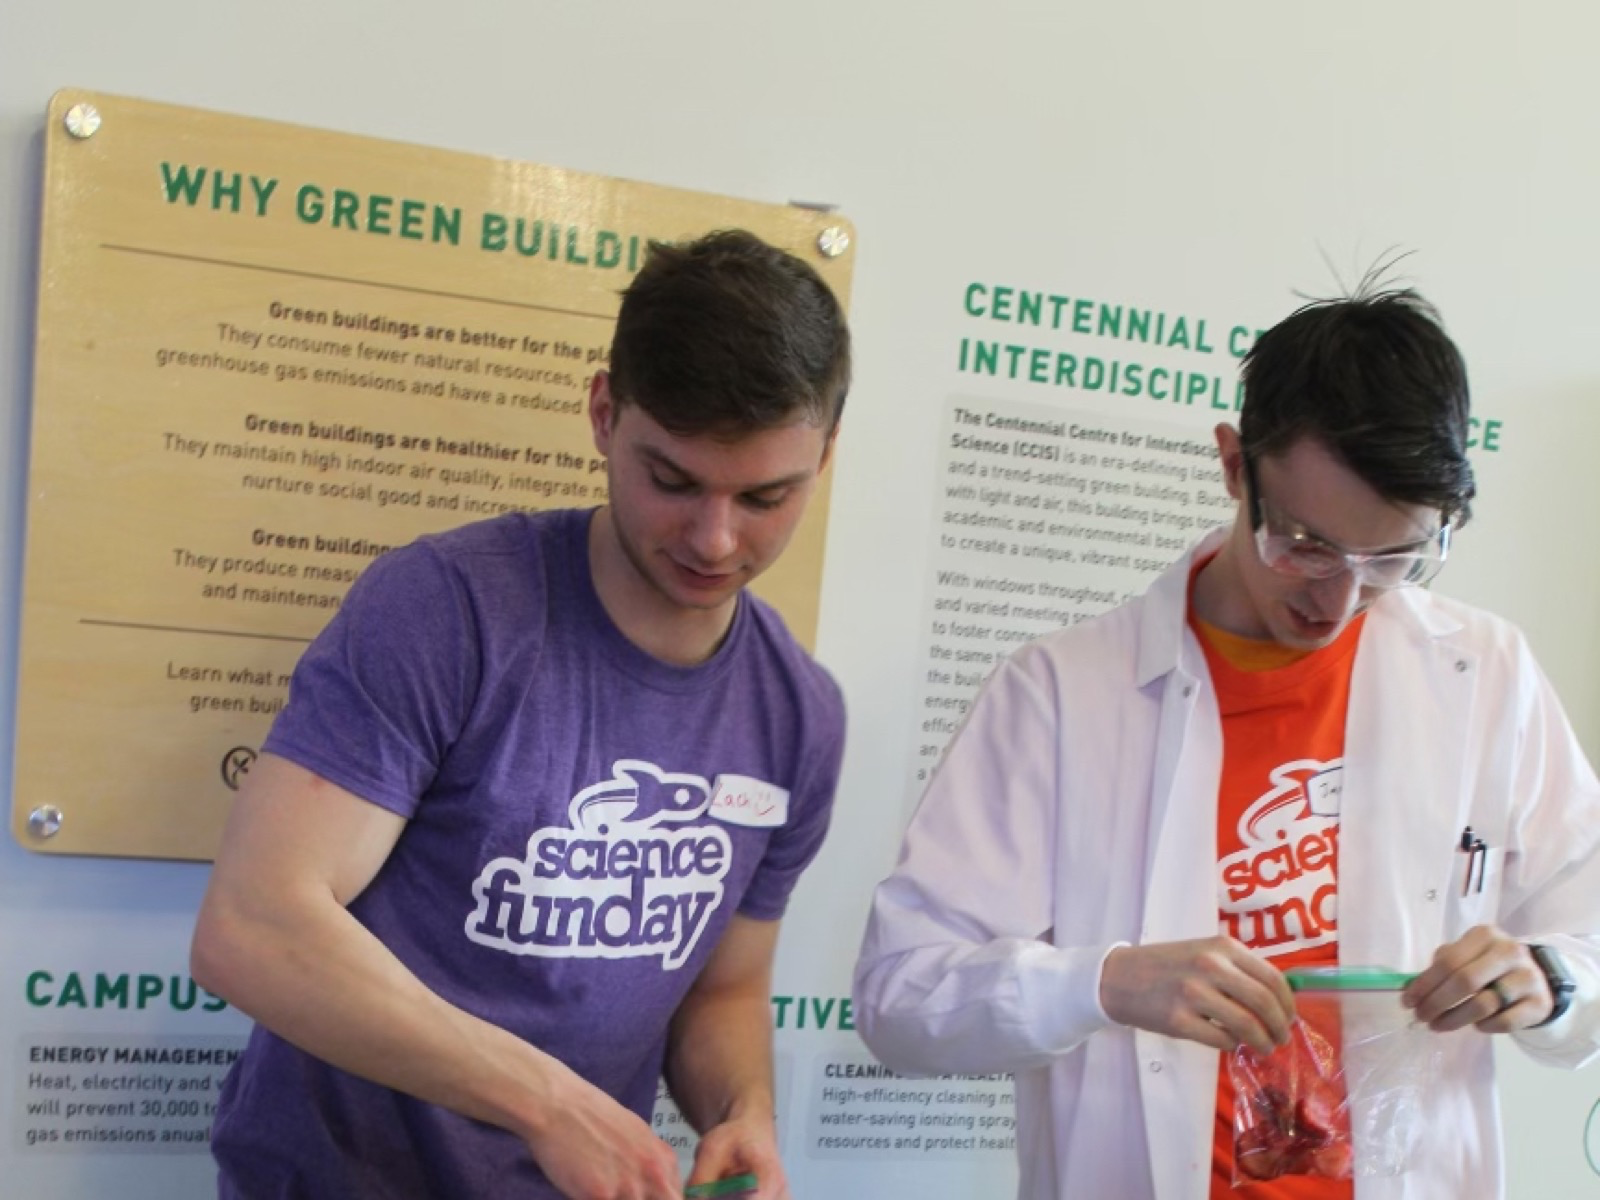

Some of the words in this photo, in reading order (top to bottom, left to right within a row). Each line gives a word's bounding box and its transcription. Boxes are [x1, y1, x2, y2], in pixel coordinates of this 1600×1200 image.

[160, 161, 279, 217] WHY
[296, 184, 462, 246] GREEN
[480, 212, 641, 272] BUILDI
[269, 301, 327, 325] Green
[332, 310, 420, 340] buildings
[424, 325, 455, 343] are
[460, 327, 516, 351] better
[521, 336, 549, 355] for
[553, 340, 581, 360] the
[964, 282, 1213, 353] CENTENNIAL
[217, 322, 262, 350] They
[266, 331, 352, 358] consume
[356, 341, 407, 364] fewer
[413, 351, 480, 375] natural
[484, 361, 577, 389] resources,
[156, 347, 270, 376] greenhouse
[275, 364, 308, 382] gas
[312, 368, 406, 393] emissions
[411, 380, 446, 397] and
[450, 383, 492, 404] have
[495, 391, 506, 406] a
[510, 393, 583, 415] reduced
[957, 338, 1243, 412] INTERDISCIPLI
[245, 414, 303, 437] Green
[308, 421, 396, 449] buildings
[400, 435, 431, 451] are
[436, 436, 521, 462] healthier
[525, 447, 550, 465] for
[555, 451, 584, 470] the
[954, 408, 981, 426] The
[986, 412, 1065, 438] Centennial
[1069, 424, 1118, 444] Centre
[1121, 431, 1143, 449] for
[163, 432, 209, 458] They
[212, 440, 297, 465] maintain
[301, 449, 342, 472] high
[346, 454, 407, 476] indoor
[410, 463, 436, 479] air
[438, 465, 505, 492] quality,
[508, 473, 588, 498] integrate
[952, 433, 1009, 454] Science
[1012, 441, 1060, 461] (CCIS)
[1064, 448, 1076, 463] is
[1079, 453, 1097, 467] an
[1101, 455, 1188, 482] era-defining
[242, 473, 314, 495] nurture
[318, 480, 372, 501] social
[377, 487, 423, 507] good
[425, 494, 460, 511] and
[948, 459, 975, 476] and
[980, 465, 988, 478] a
[991, 466, 1087, 492] trend-setting
[1090, 477, 1131, 496] green
[946, 484, 977, 499] with
[980, 486, 1012, 507] light
[1014, 493, 1040, 508] and
[1067, 498, 1093, 515] this
[1095, 502, 1149, 526] building
[1152, 508, 1194, 530] brings
[252, 528, 309, 549] Green
[943, 511, 1013, 531] academic
[1018, 519, 1045, 534] and
[1049, 519, 1151, 547] environmental
[174, 548, 217, 574] They
[222, 556, 297, 578] produce
[941, 534, 956, 548] to
[959, 538, 1006, 554] create
[1010, 543, 1019, 555] a
[1080, 549, 1130, 567] vibrant
[202, 582, 237, 599] and
[242, 585, 340, 609] maintenan
[937, 569, 970, 587] With
[973, 576, 1036, 595] windows
[1038, 582, 1118, 605] throughout,
[935, 598, 962, 612] and
[964, 601, 1010, 617] varied
[1012, 606, 1069, 627] meeting
[932, 621, 947, 634] to
[949, 622, 992, 640] foster
[930, 644, 951, 660] the
[955, 650, 992, 663] same
[167, 662, 221, 683] Learn
[228, 668, 272, 686] what
[927, 670, 951, 685] the
[190, 695, 243, 713] green
[925, 697, 968, 713] energ
[533, 824, 724, 881] science
[475, 868, 716, 961] funday
[771, 997, 856, 1030] TIVE
[30, 1046, 107, 1063] ENERGY
[825, 1064, 902, 1078] CLEANIN
[29, 1074, 77, 1091] Heat,
[83, 1074, 172, 1093] electricity
[178, 1075, 211, 1091] and
[822, 1087, 933, 1105] High-efficiency
[936, 1091, 996, 1107] cleaning
[27, 1101, 59, 1116] will
[66, 1101, 134, 1118] prevent
[140, 1102, 199, 1117] 30,000
[820, 1112, 916, 1129] water-saving
[920, 1112, 975, 1130] ionizing
[27, 1129, 58, 1145] gas
[64, 1126, 155, 1142] emissions
[818, 1136, 890, 1149] resources
[894, 1136, 920, 1149] and
[925, 1136, 976, 1152] protect
